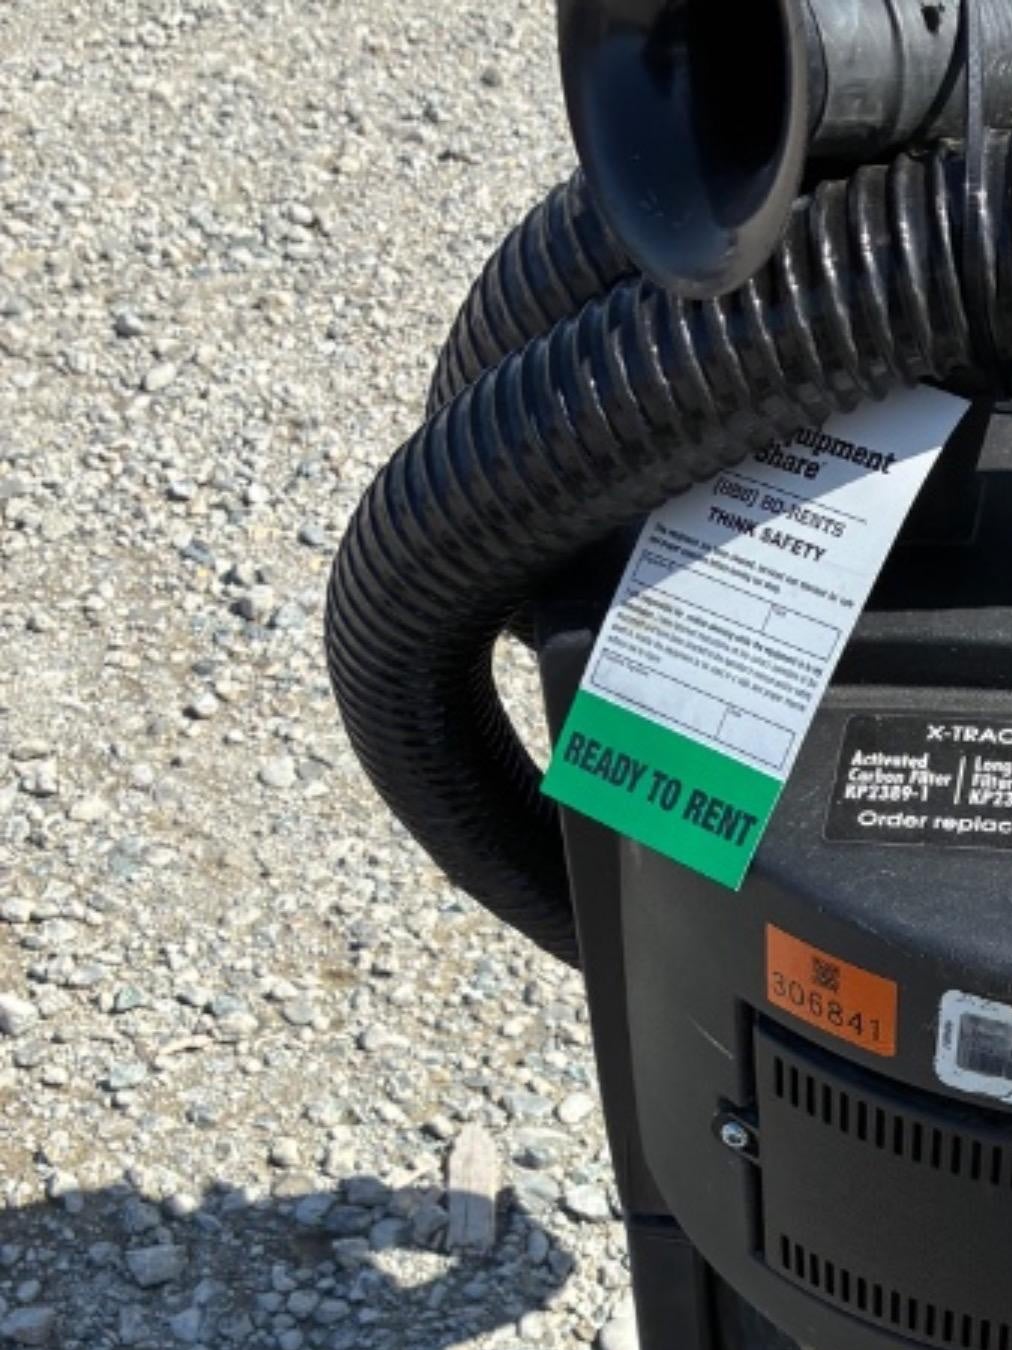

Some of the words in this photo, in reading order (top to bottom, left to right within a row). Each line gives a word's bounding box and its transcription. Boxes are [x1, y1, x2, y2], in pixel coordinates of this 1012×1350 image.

[783, 427, 897, 474] uipment
[708, 505, 760, 538] THINK
[760, 526, 827, 561] SAFETY
[848, 766, 904, 785] Carbon
[908, 769, 952, 787] Filter
[850, 749, 930, 769] Activated
[563, 731, 648, 793] READY
[647, 770, 682, 812] TO
[682, 788, 759, 847] RENT
[857, 809, 927, 830] Order
[773, 971, 880, 1042] 306841
